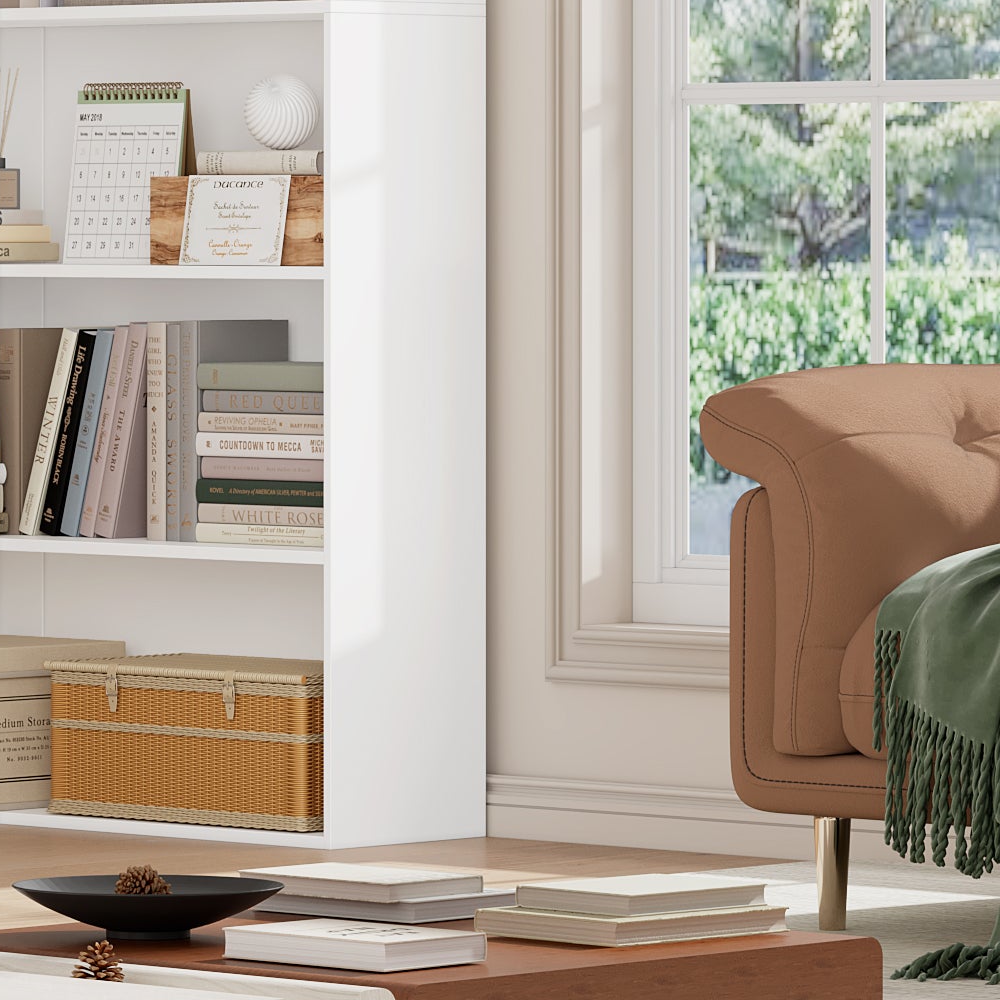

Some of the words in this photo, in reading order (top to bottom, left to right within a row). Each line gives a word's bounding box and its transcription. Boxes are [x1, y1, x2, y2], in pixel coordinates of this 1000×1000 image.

[75, 345, 87, 363] Life
[126, 340, 139, 378] DANIELLE
[65, 364, 83, 405] Drawing
[121, 376, 132, 398] STEEL
[230, 394, 263, 409] RED
[35, 396, 58, 464] WINTER
[117, 410, 126, 430] THE
[215, 416, 246, 425] REVIVING
[56, 433, 68, 459] ROBIN
[109, 435, 121, 472] AWARD
[219, 440, 264, 450] COUNTDOWN
[266, 442, 275, 450] TO
[278, 442, 302, 451] MECCA
[51, 458, 62, 484] BLACK
[232, 509, 281, 522] WHITE
[288, 512, 324, 525] ROSE
[28, 716, 51, 726] Stora
